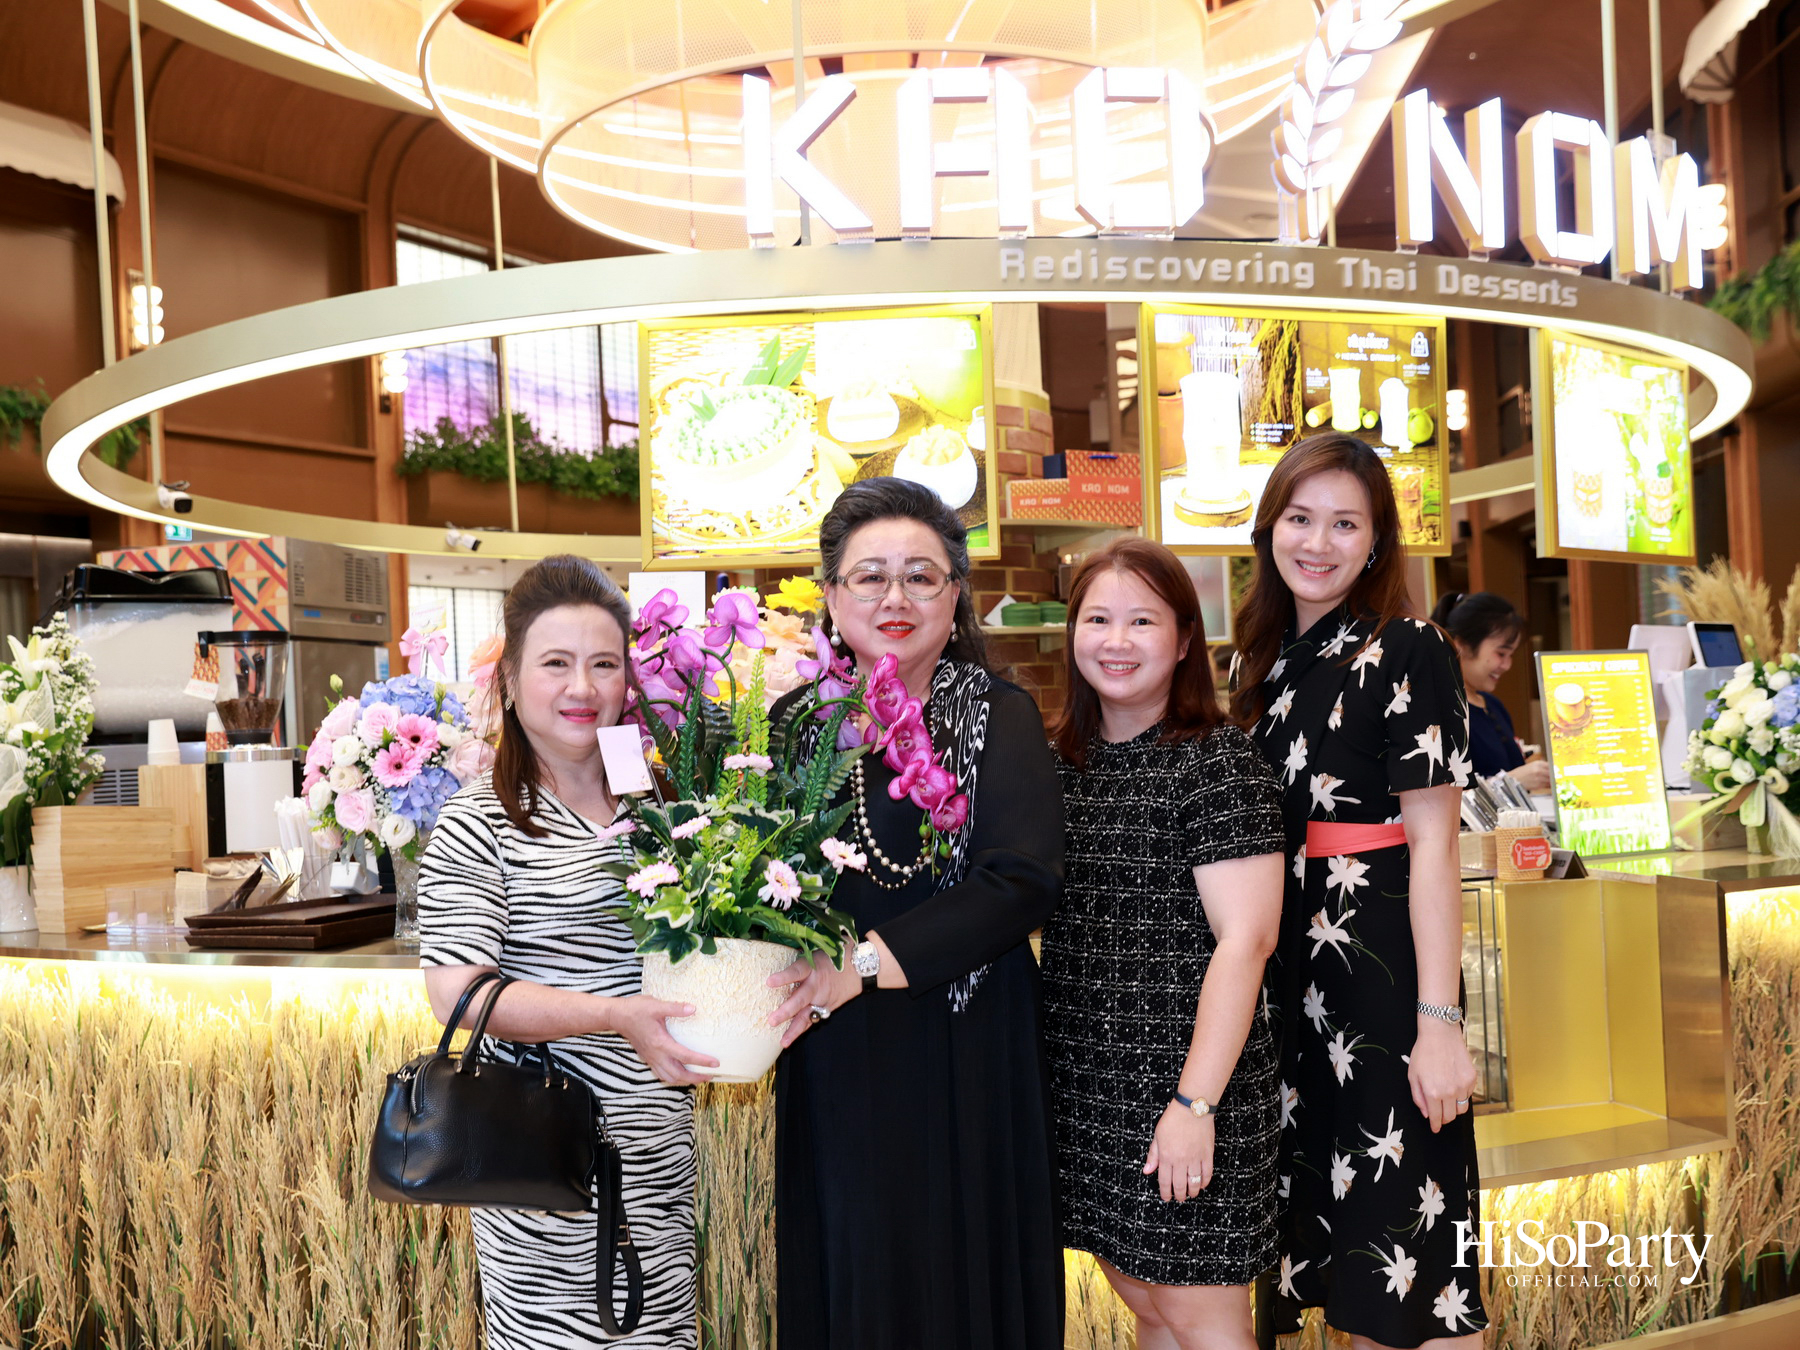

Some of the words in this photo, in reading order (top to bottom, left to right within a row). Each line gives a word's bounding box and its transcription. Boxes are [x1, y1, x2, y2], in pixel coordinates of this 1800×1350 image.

[742, 65, 1205, 238] KAO
[1392, 87, 1704, 291] NOM
[1000, 247, 1315, 290] Rediscovering
[1337, 256, 1417, 292] Thai
[1437, 264, 1578, 308] Desserts
[1107, 484, 1130, 494] NOM
